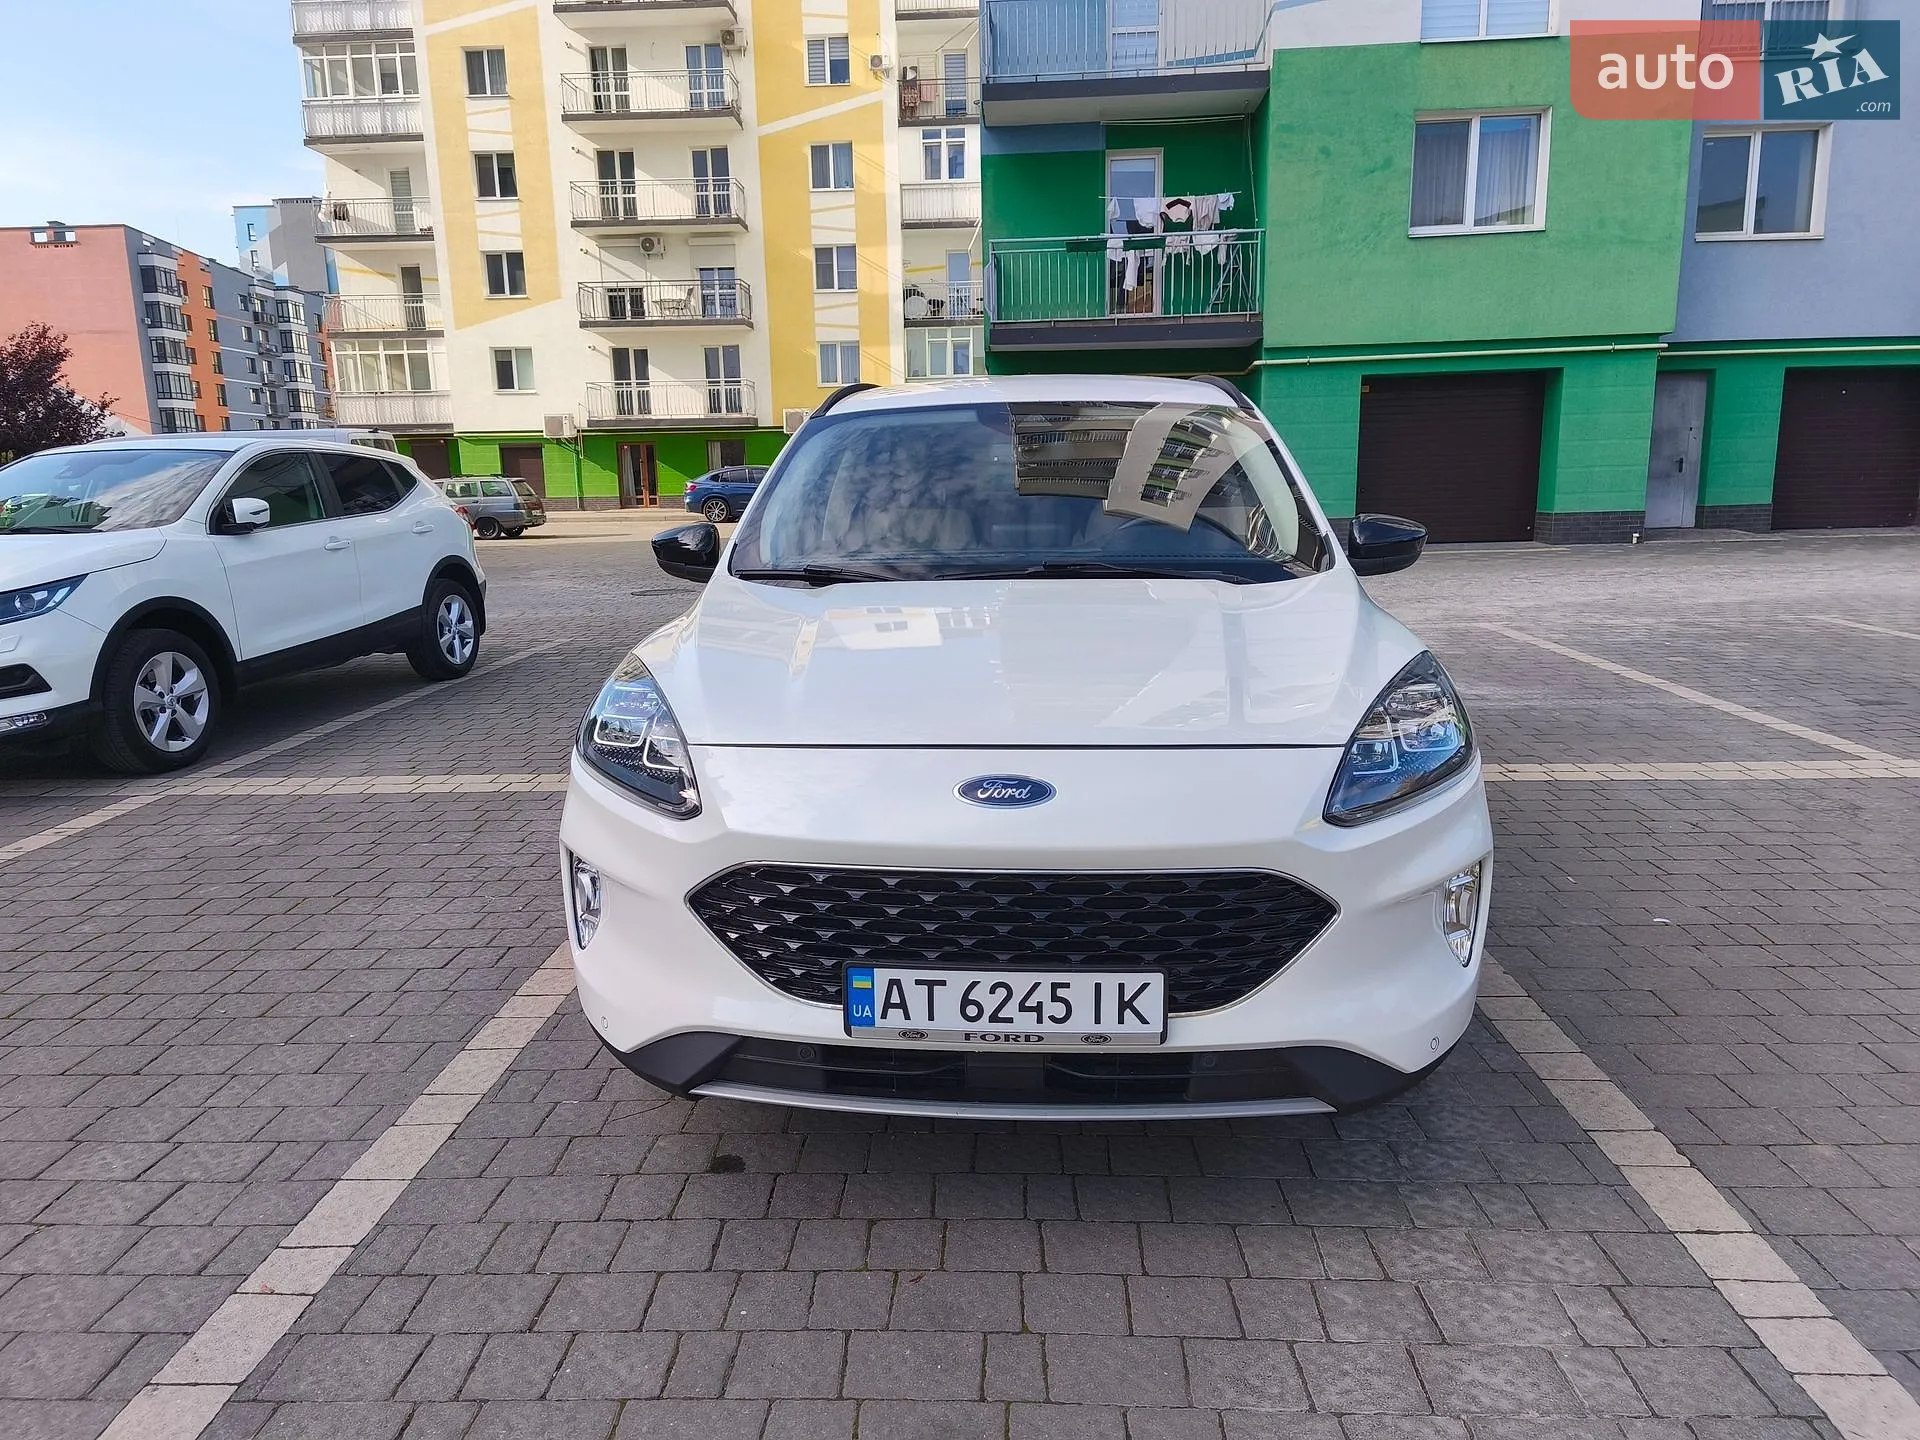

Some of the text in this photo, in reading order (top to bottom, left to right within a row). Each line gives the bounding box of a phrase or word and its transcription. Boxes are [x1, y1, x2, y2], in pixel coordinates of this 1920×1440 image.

[977, 779, 1032, 799] Ford
[879, 978, 1152, 1025] AT 6245 IK
[853, 1004, 873, 1018] UA
[964, 1032, 1045, 1043] FORD
